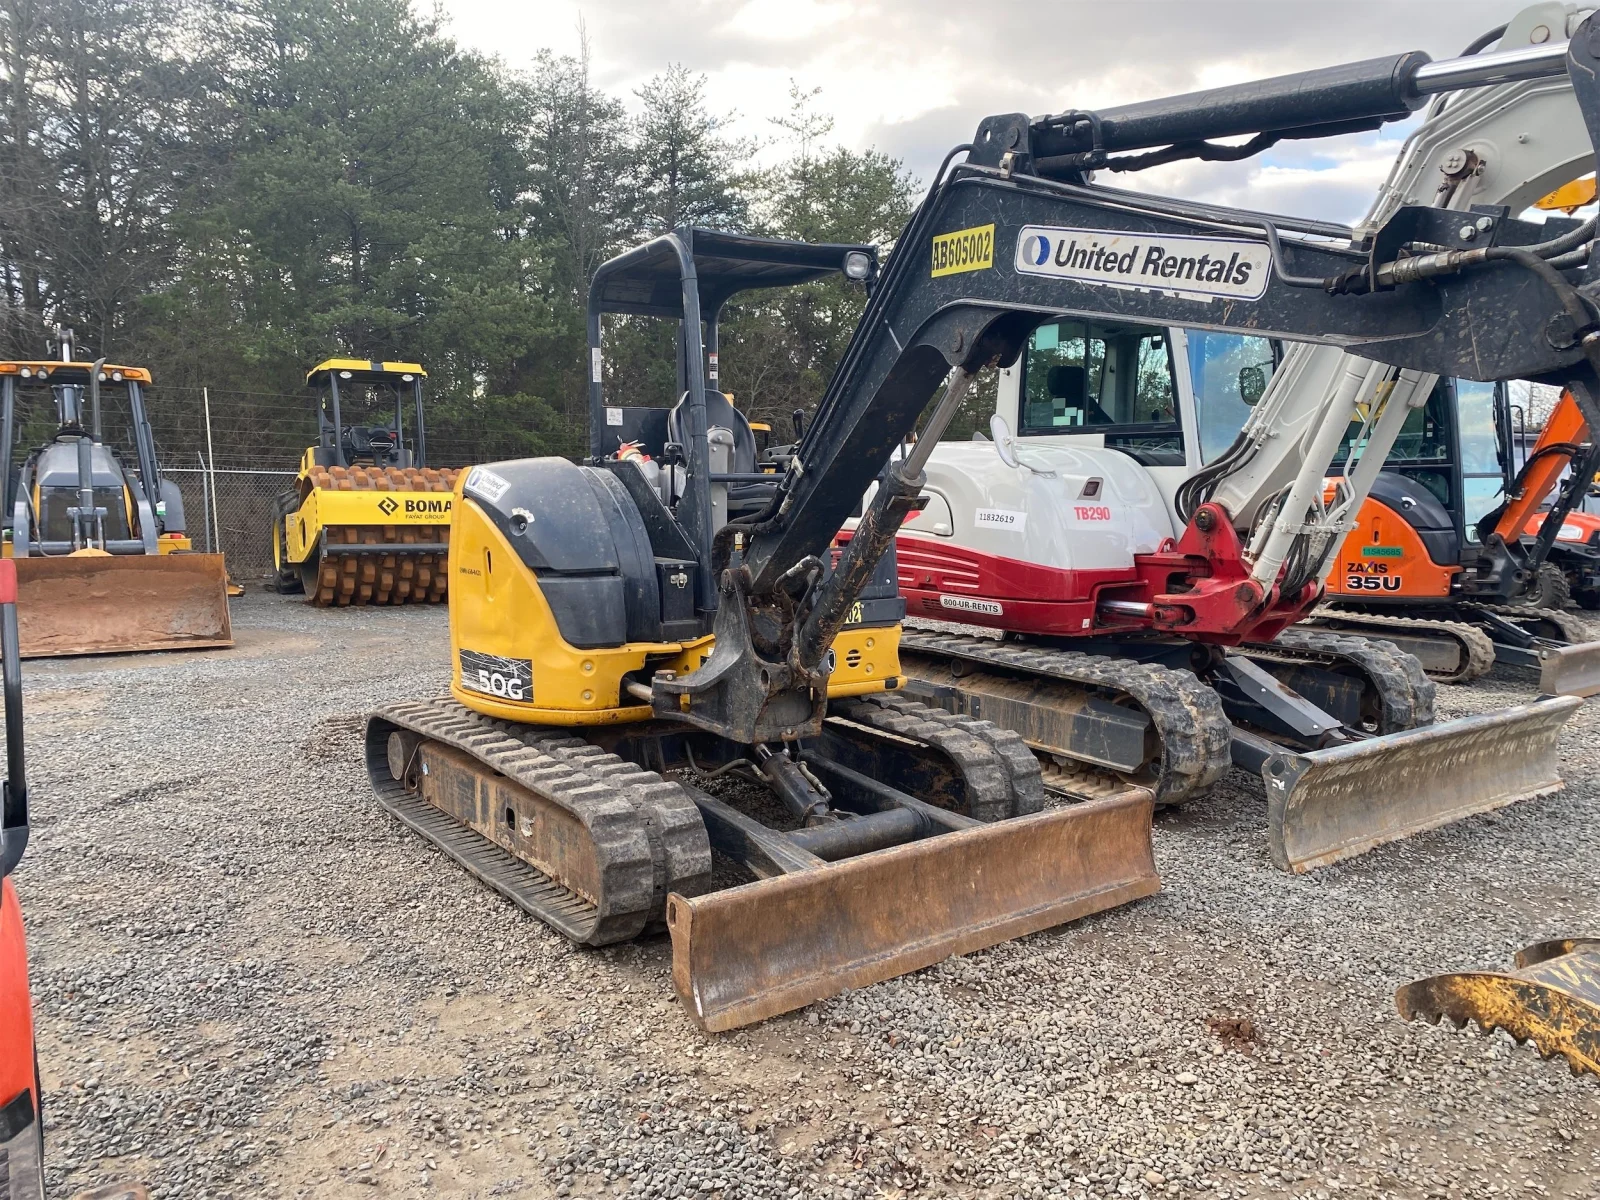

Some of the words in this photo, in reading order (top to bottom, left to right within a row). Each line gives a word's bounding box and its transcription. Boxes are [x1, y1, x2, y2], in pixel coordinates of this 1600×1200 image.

[932, 231, 990, 270] AB605002
[1055, 239, 1139, 274] United
[1141, 246, 1252, 285] Rentals
[481, 474, 505, 490] United
[979, 513, 1015, 523] 11832619
[1074, 506, 1110, 520] TB290
[1347, 561, 1388, 573] ZAXIS
[1346, 575, 1402, 591] 35U
[943, 599, 999, 612] 800-UR-RENTS
[478, 669, 523, 700] 50G
